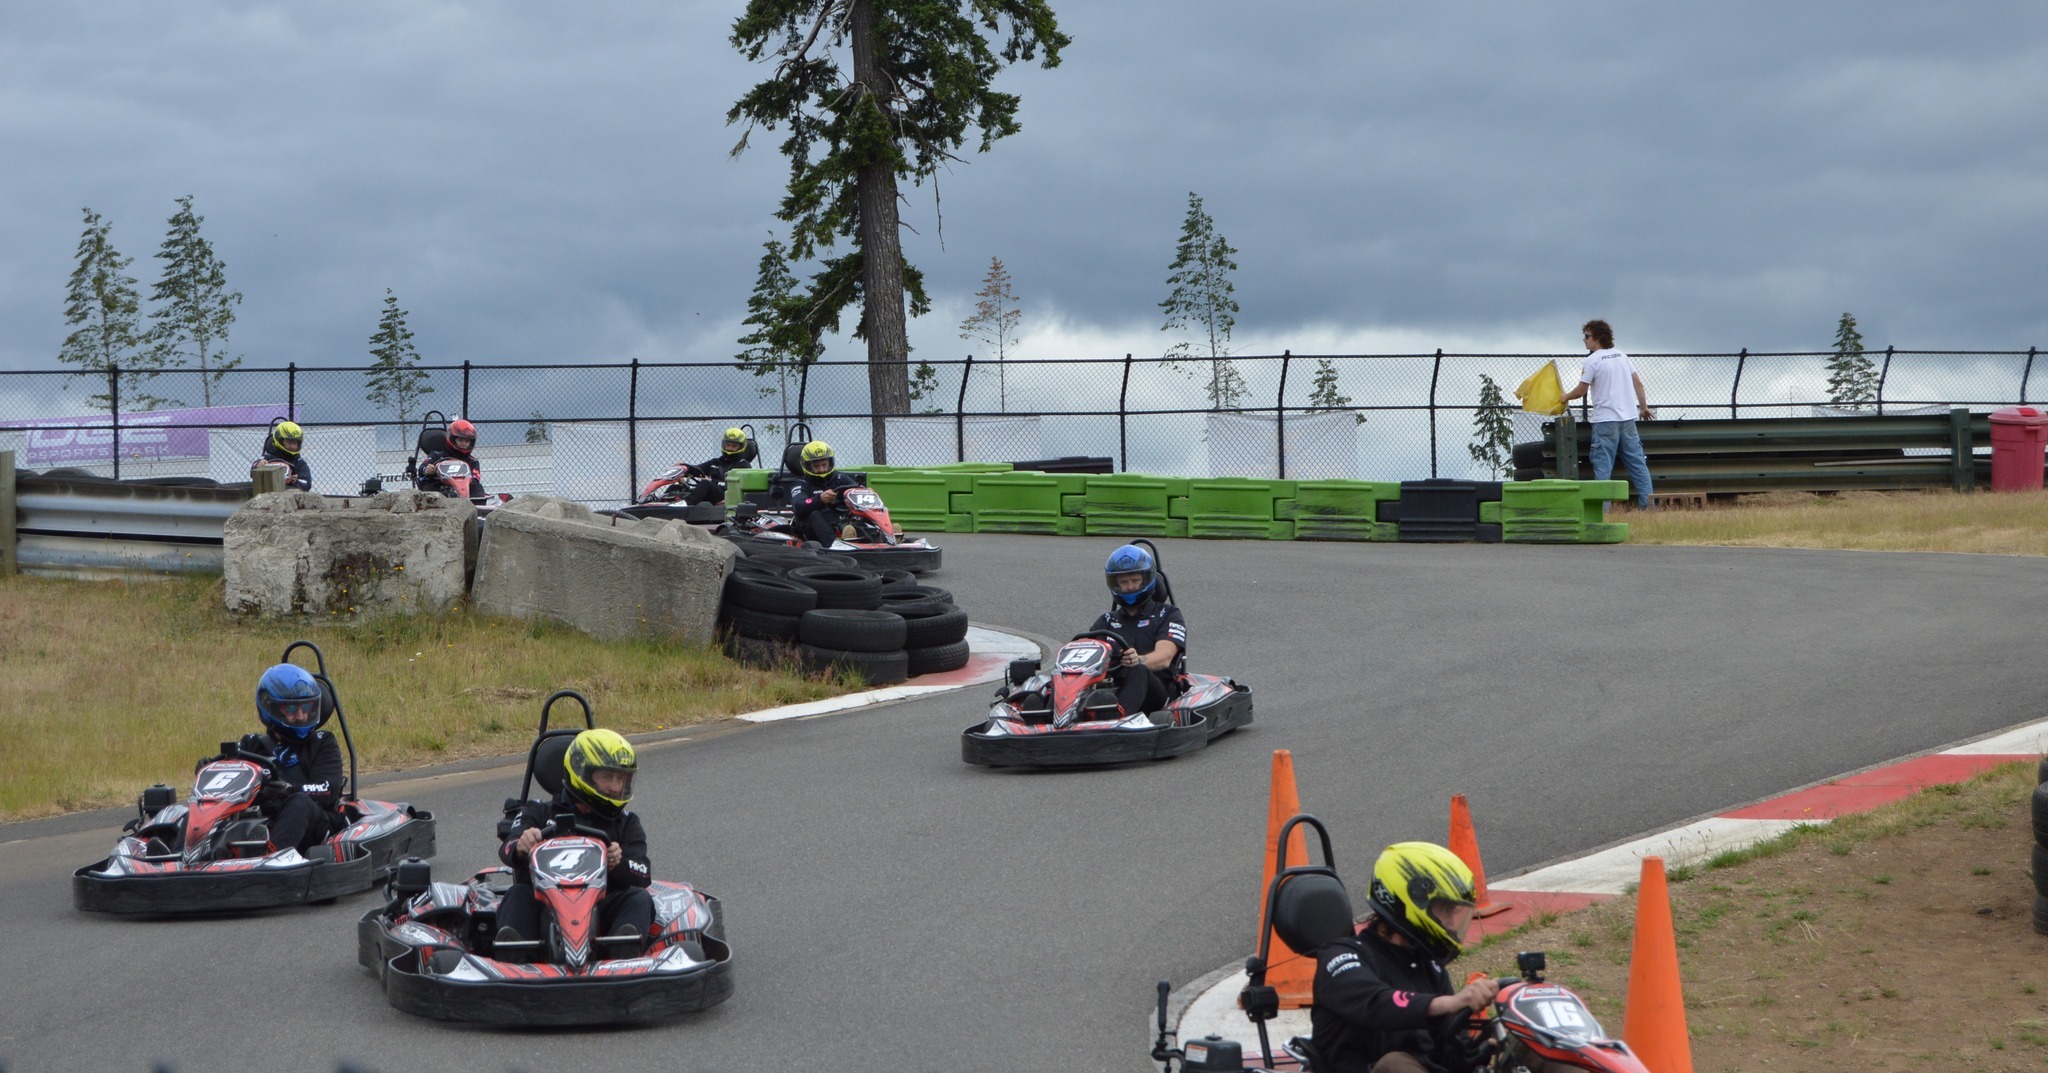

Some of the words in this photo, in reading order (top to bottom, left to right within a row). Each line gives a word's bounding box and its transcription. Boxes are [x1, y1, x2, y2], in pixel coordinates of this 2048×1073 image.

[119, 445, 170, 457] PARK
[446, 465, 461, 473] 9
[856, 494, 876, 504] 14
[1060, 648, 1098, 664] 13
[204, 771, 240, 790] 6
[549, 848, 586, 870] 4
[1536, 1001, 1585, 1029] 16
